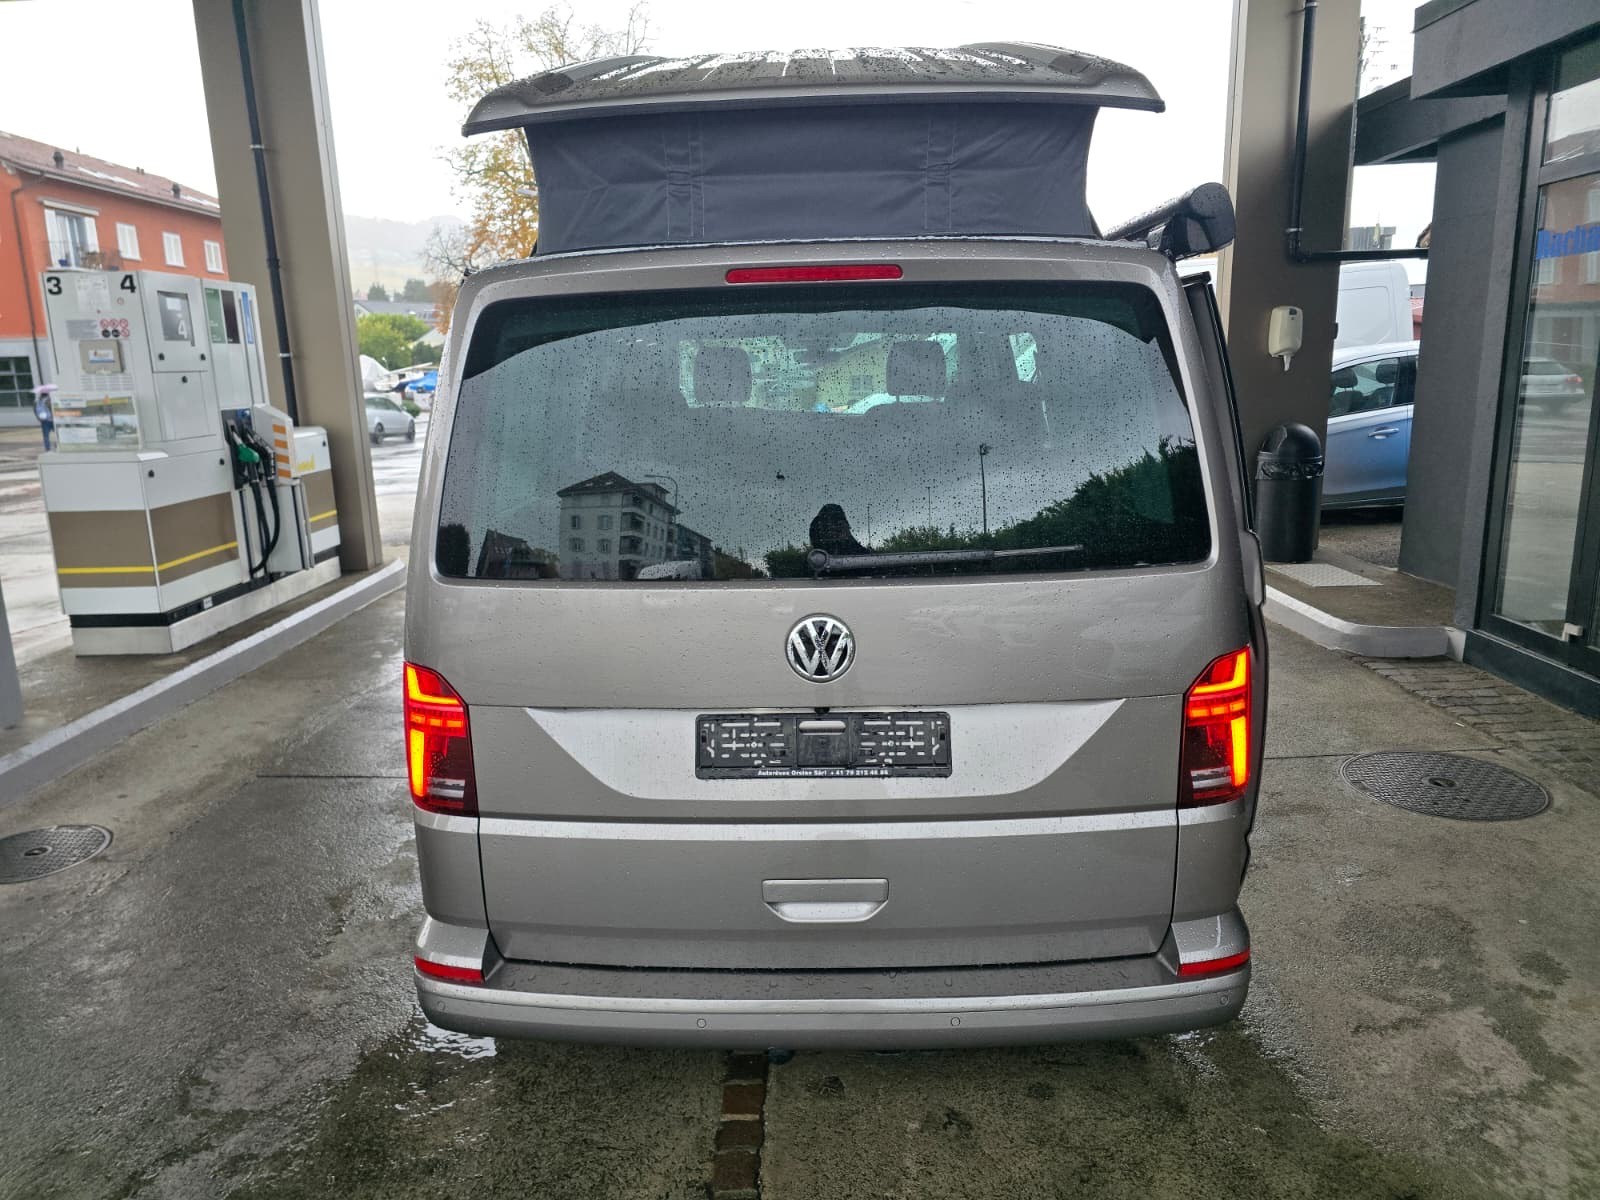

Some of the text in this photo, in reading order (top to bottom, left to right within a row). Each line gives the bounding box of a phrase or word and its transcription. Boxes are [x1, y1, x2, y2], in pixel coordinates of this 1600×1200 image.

[46, 276, 62, 295] 3
[120, 274, 136, 293] 4
[178, 320, 188, 339] 4
